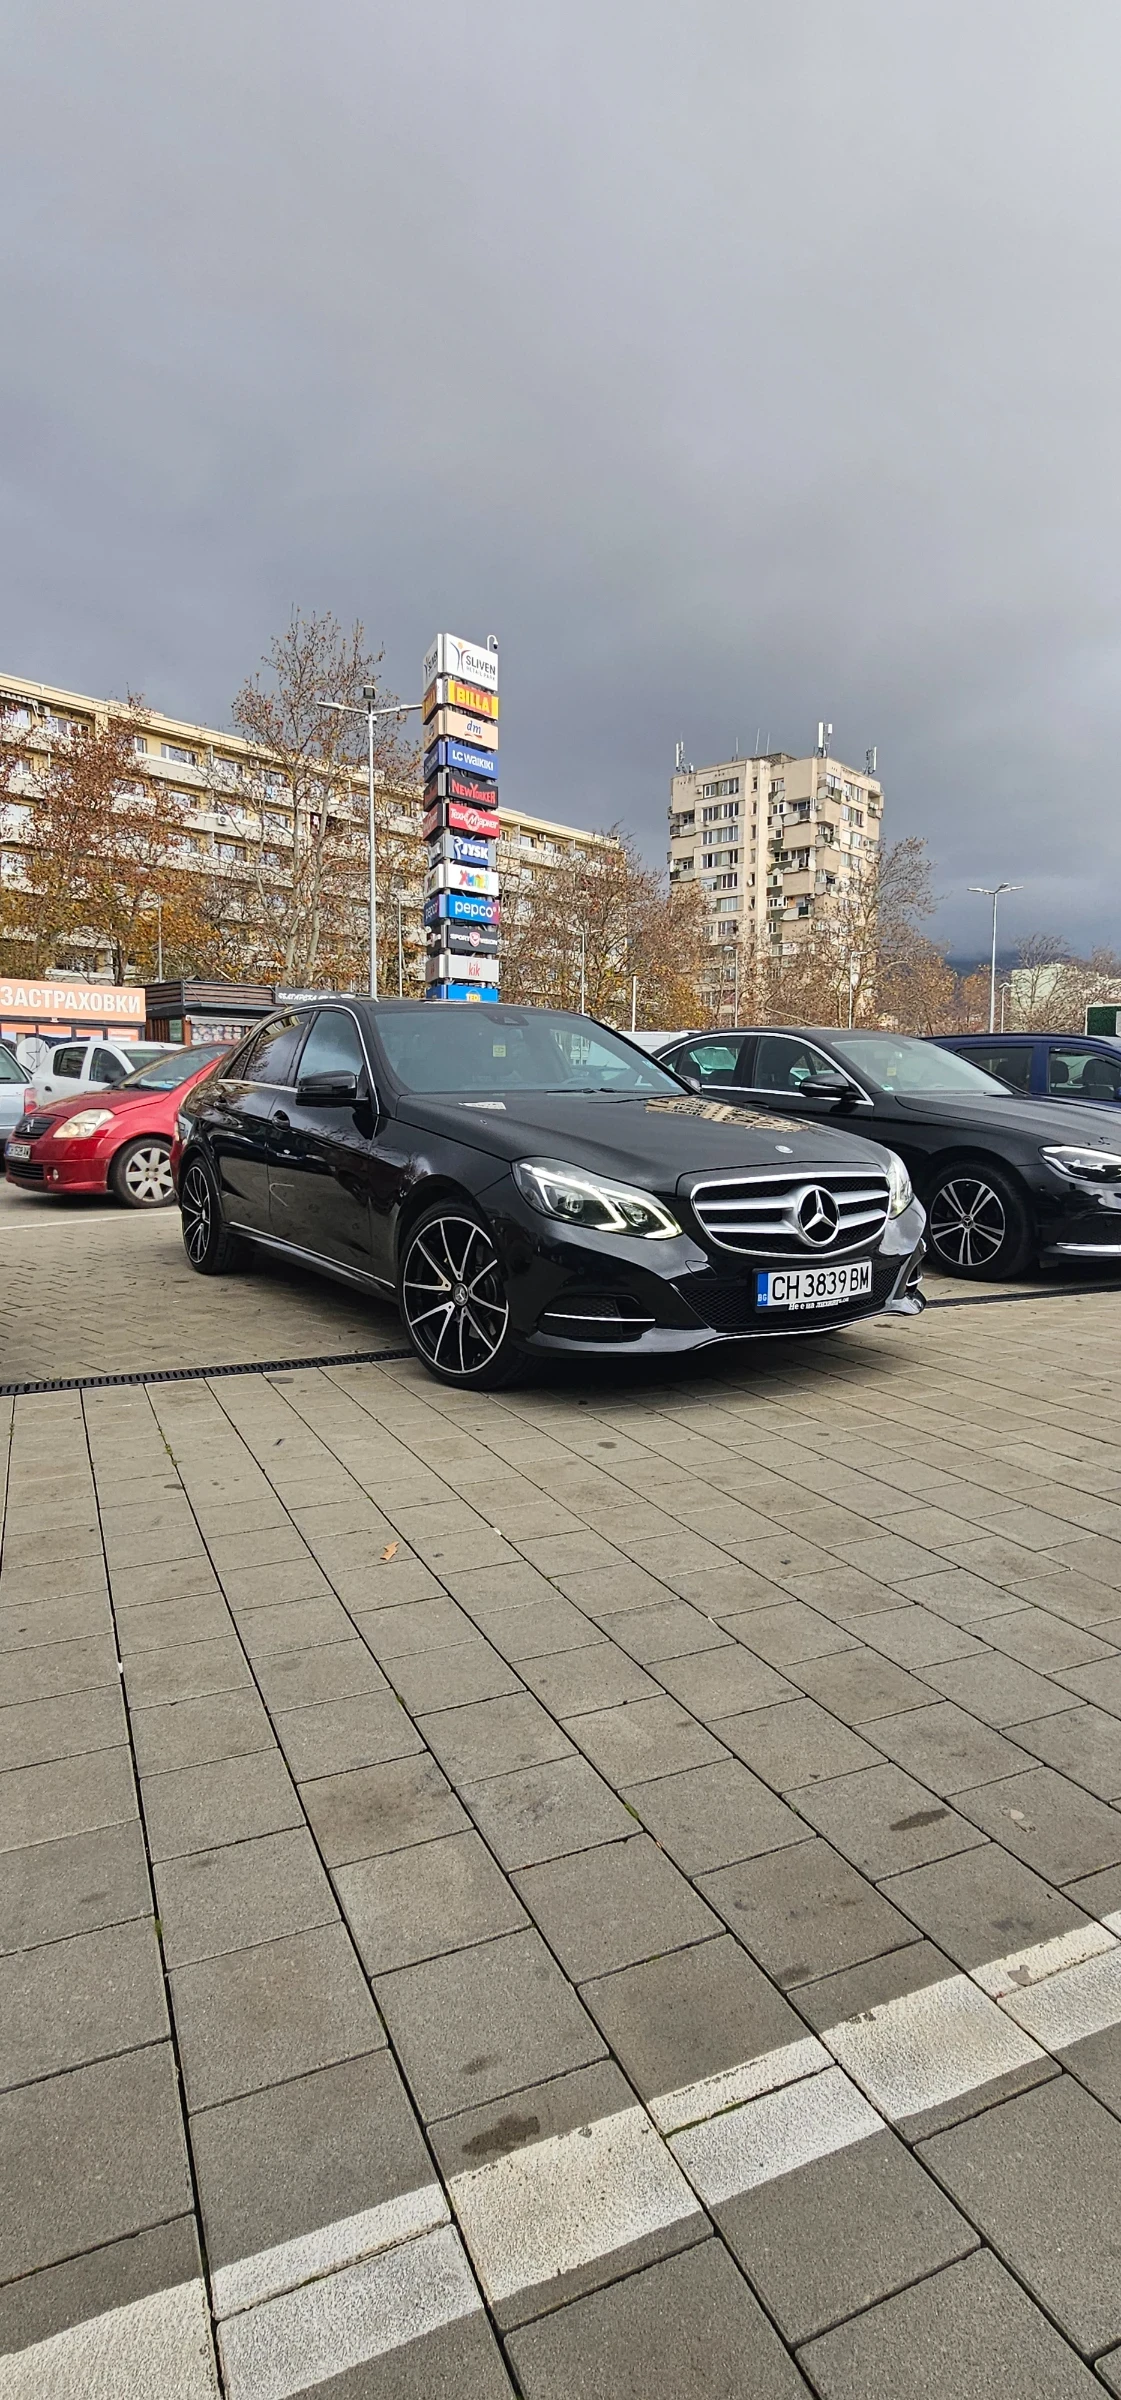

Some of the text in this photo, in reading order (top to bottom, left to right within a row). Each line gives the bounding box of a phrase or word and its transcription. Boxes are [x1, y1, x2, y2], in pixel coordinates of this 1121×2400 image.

[466, 655, 496, 676] SLIVEN
[456, 686, 490, 713] BILLA
[466, 720, 482, 735] dm
[452, 749, 464, 762] LC
[461, 843, 489, 859] JYSK
[454, 901, 494, 918] pepco
[468, 962, 481, 976] kik
[0, 986, 141, 1014] ЗАСТРАХОВКИ
[772, 1266, 869, 1301] CH 3839 BM
[757, 1293, 767, 1302] BG
